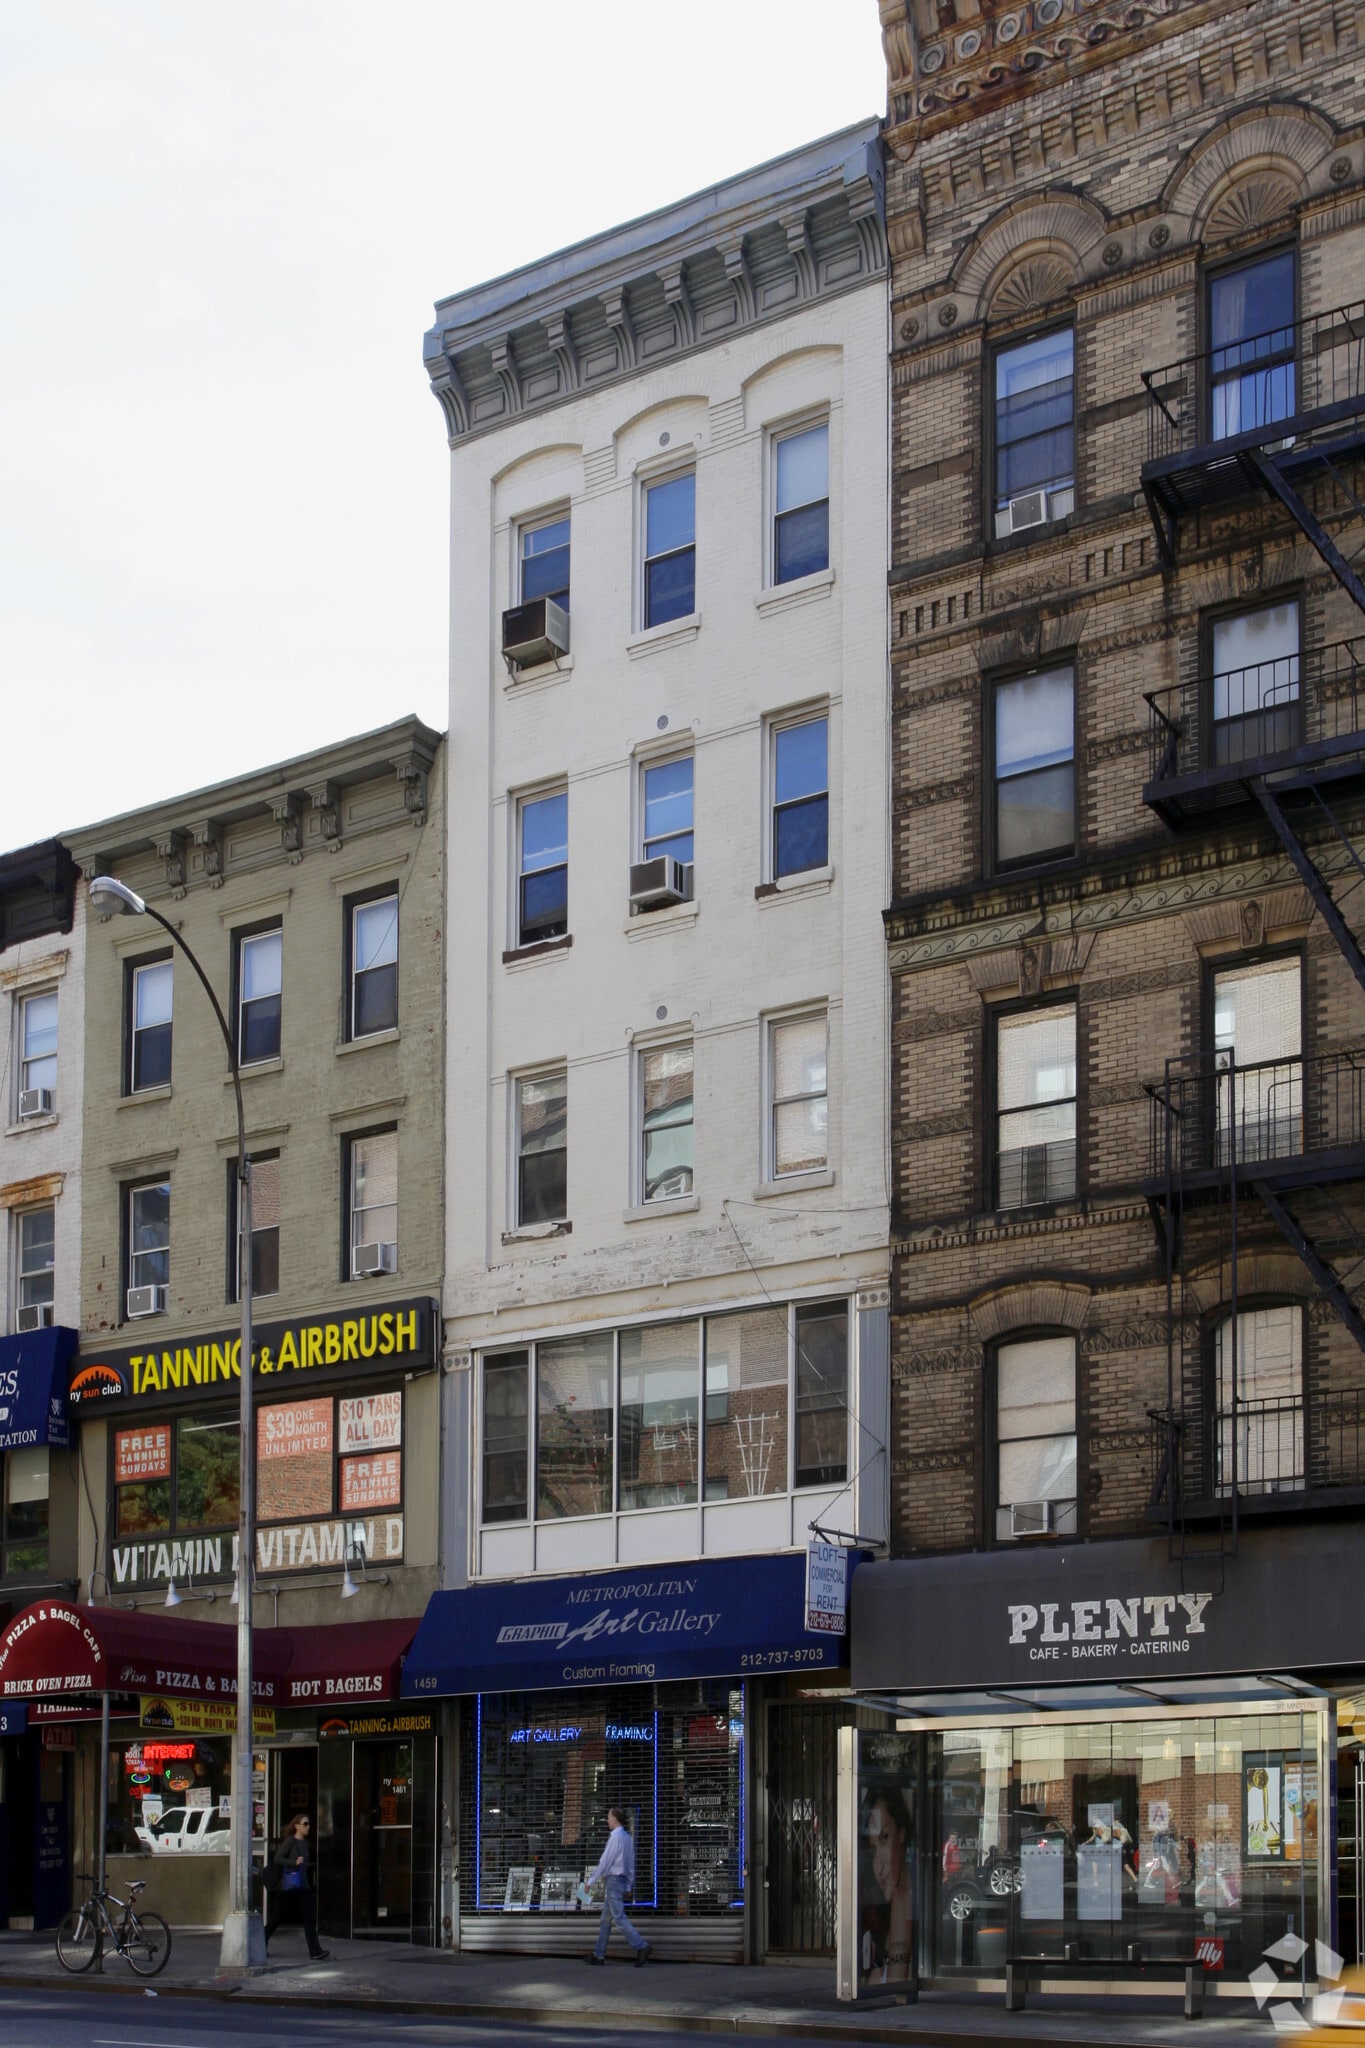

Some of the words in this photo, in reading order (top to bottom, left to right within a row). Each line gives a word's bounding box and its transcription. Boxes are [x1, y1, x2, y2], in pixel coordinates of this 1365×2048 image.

[130, 1338, 255, 1395] TANNING
[260, 1346, 273, 1375] &
[277, 1310, 417, 1372] AIRBRUSH
[70, 1391, 81, 1402] ny
[83, 1387, 100, 1399] sun
[102, 1383, 122, 1396] club
[342, 1400, 364, 1421] $10
[368, 1393, 401, 1418] TANS
[266, 1411, 295, 1441] $39
[296, 1408, 314, 1421] ONE
[295, 1421, 327, 1436] MONTH
[346, 1422, 369, 1443] ALL
[373, 1418, 397, 1439] DAY
[121, 1433, 166, 1453] FREE
[265, 1436, 327, 1455] UNLIMITED
[121, 1449, 166, 1464] TANNING
[345, 1459, 397, 1479] FREE
[345, 1475, 397, 1491] TANNING
[256, 1521, 374, 1568] VITAMIN
[386, 1518, 403, 1556] D
[113, 1537, 222, 1583] VITAMIN
[818, 1547, 839, 1563] LOFT
[811, 1565, 845, 1585] COMMERCIAL
[566, 1579, 698, 1605] METROPOLITAN
[822, 1584, 833, 1594] FOR
[816, 1595, 838, 1611] RENT
[1008, 1593, 1213, 1644] PLENTY
[7, 1615, 36, 1646] PIZZA
[39, 1609, 47, 1620] &
[50, 1608, 81, 1630] BAGEL
[83, 1628, 102, 1663] CAFE
[501, 1623, 566, 1642] GRAPHIC
[556, 1608, 640, 1650] Art
[637, 1609, 722, 1636] Gallery
[740, 1648, 824, 1667] 212-737-9703
[1030, 1647, 1060, 1660] CAFE
[1072, 1644, 1118, 1658] BAKERY
[1130, 1640, 1190, 1655] CATERING
[120, 1664, 149, 1684] Pisa
[156, 1670, 201, 1690] PIZZA
[205, 1675, 216, 1691] &
[220, 1677, 274, 1697] BAELS
[562, 1666, 606, 1681] Custom
[609, 1662, 655, 1679] Framing
[4, 1679, 34, 1694] BRICK
[36, 1676, 63, 1691] OVEN
[64, 1674, 92, 1689] PIZZA
[291, 1680, 321, 1697] HOT
[325, 1675, 383, 1695] BAGELS
[414, 1677, 437, 1690] 1459
[180, 1701, 200, 1713] $10
[203, 1704, 231, 1715] TANS
[253, 1709, 273, 1719] DAY
[350, 1717, 387, 1734] TANNING
[393, 1715, 431, 1732] AIRBRUSH
[605, 1725, 653, 1741] FRAMING
[46, 1726, 73, 1745] ATM
[510, 1729, 531, 1743] ART
[533, 1727, 583, 1742] GALLERY
[143, 1744, 195, 1759] INTERNET
[383, 1777, 392, 1785] ny
[1152, 1805, 1166, 1822] A
[1196, 1942, 1223, 1967] illy
